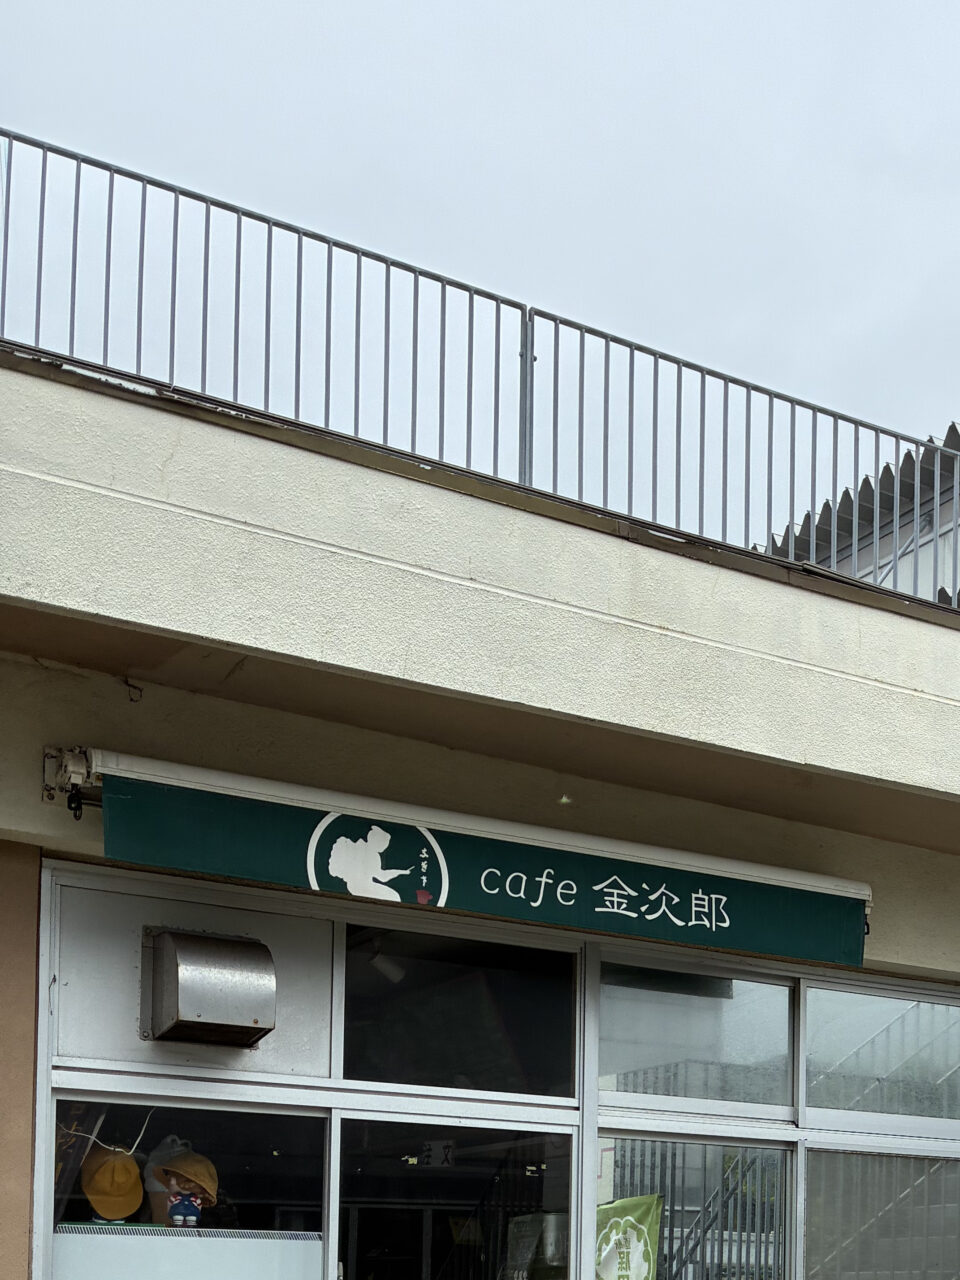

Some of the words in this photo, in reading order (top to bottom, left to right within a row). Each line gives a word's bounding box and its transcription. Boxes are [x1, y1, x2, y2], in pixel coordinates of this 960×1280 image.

[480, 868, 577, 908] cafe
[592, 875, 730, 932] 金次郎
